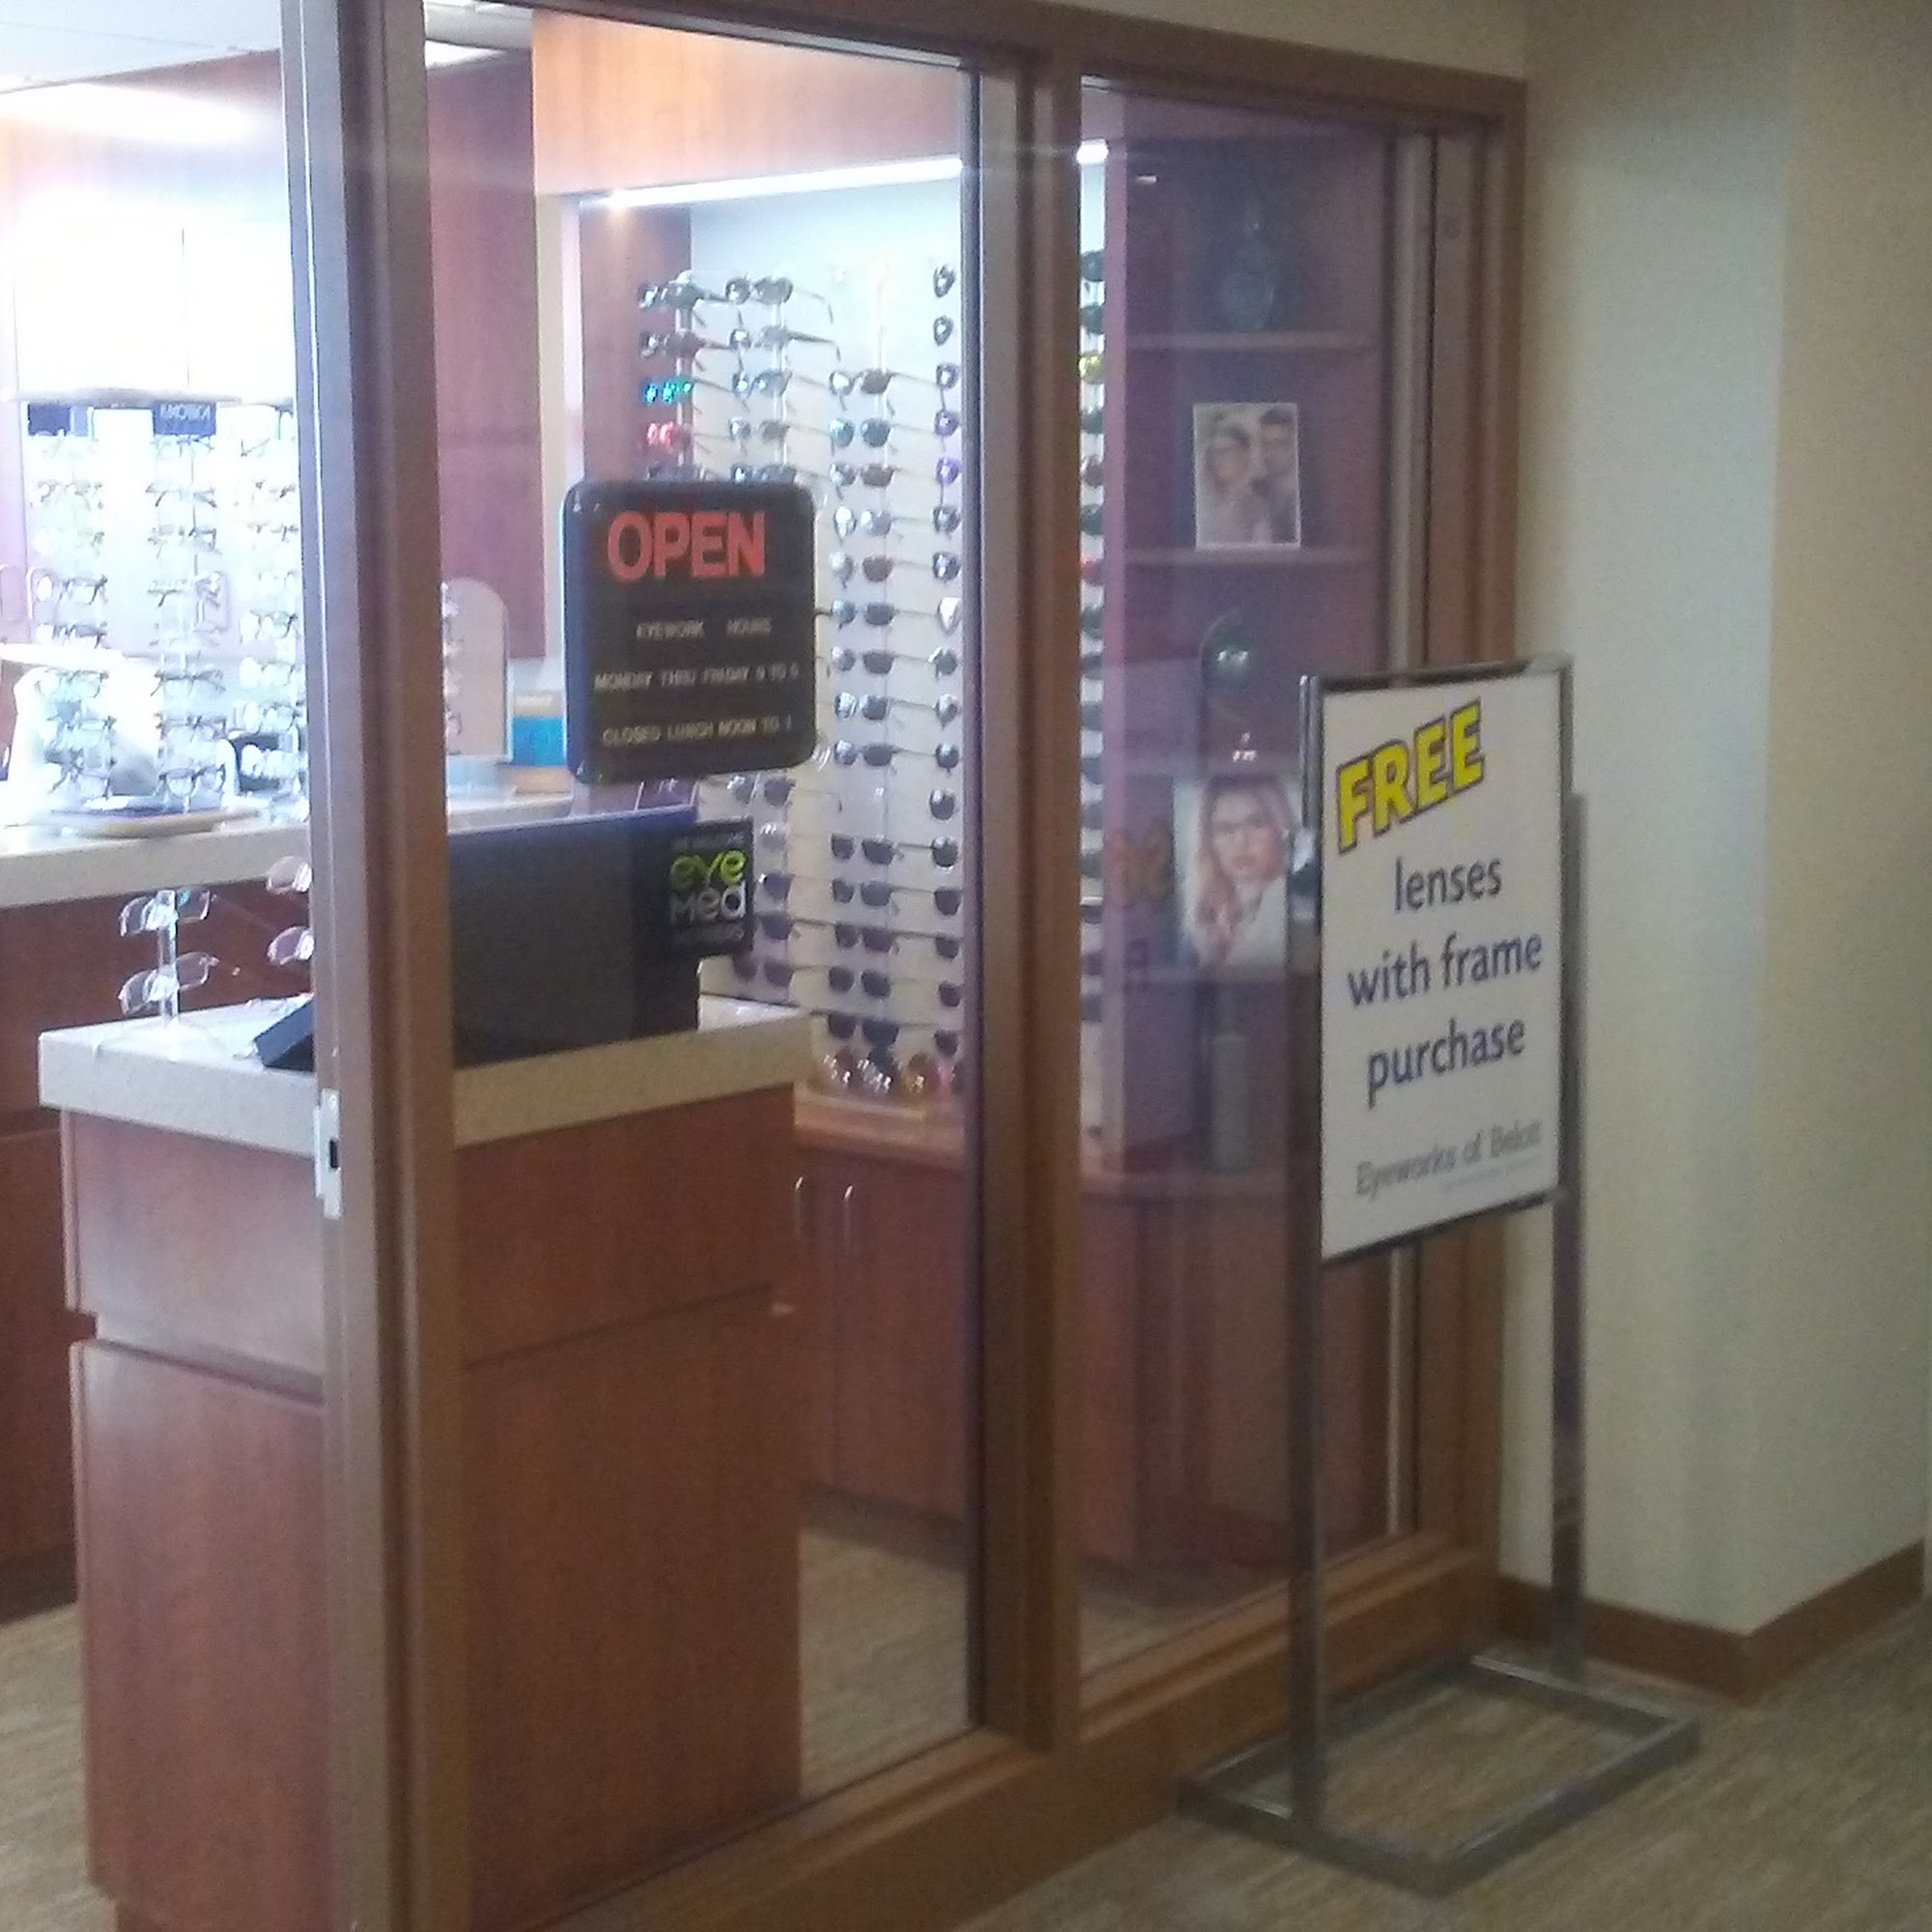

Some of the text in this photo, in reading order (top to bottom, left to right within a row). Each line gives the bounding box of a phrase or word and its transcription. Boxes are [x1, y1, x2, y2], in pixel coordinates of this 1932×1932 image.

[608, 510, 765, 580] OPEN
[594, 670, 653, 690] MONDAY
[661, 668, 696, 687] THRU
[702, 666, 750, 685] FRIDAY
[602, 724, 662, 747] CLOSED
[667, 721, 714, 743] LUNCH
[718, 717, 757, 738] NOON
[1336, 696, 1485, 856] FREE
[670, 850, 746, 891] eye
[1395, 857, 1502, 911] lenses
[1348, 931, 1543, 1007] with frame
[1368, 1017, 1526, 1110] purchase
